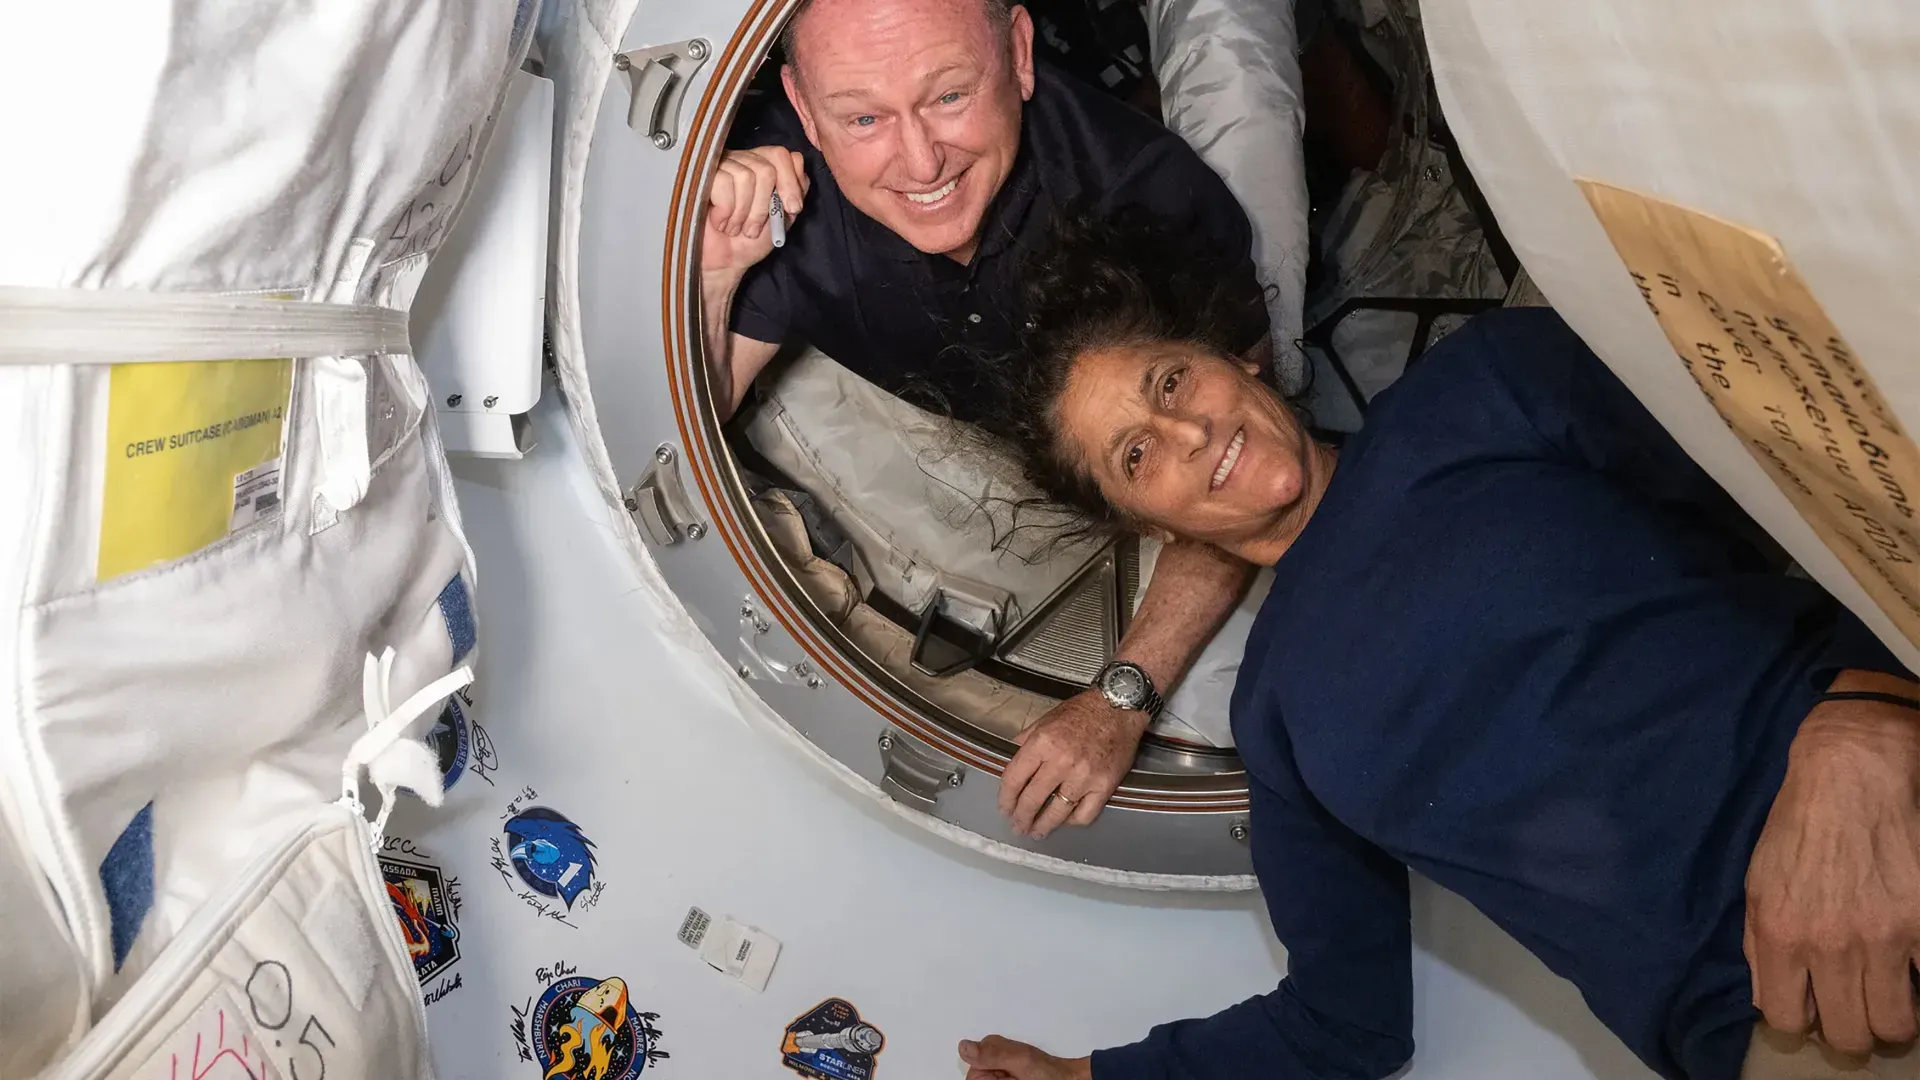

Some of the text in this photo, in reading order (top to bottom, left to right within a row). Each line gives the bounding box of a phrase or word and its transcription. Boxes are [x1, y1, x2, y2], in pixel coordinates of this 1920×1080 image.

[1657, 273, 1681, 298] in
[1696, 341, 1731, 389] the
[1698, 290, 1762, 374] cover
[126, 437, 166, 459] CREW
[169, 424, 222, 450] SUITCASE
[680, 909, 697, 938] RESTRAINT
[685, 912, 704, 944] WATER LINE
[692, 917, 709, 944] FUEL CELL
[555, 979, 581, 993] CHARI
[533, 1000, 549, 1059] MARSHBURN
[630, 1017, 645, 1054] MAURER
[819, 1053, 866, 1077] STARLINER
